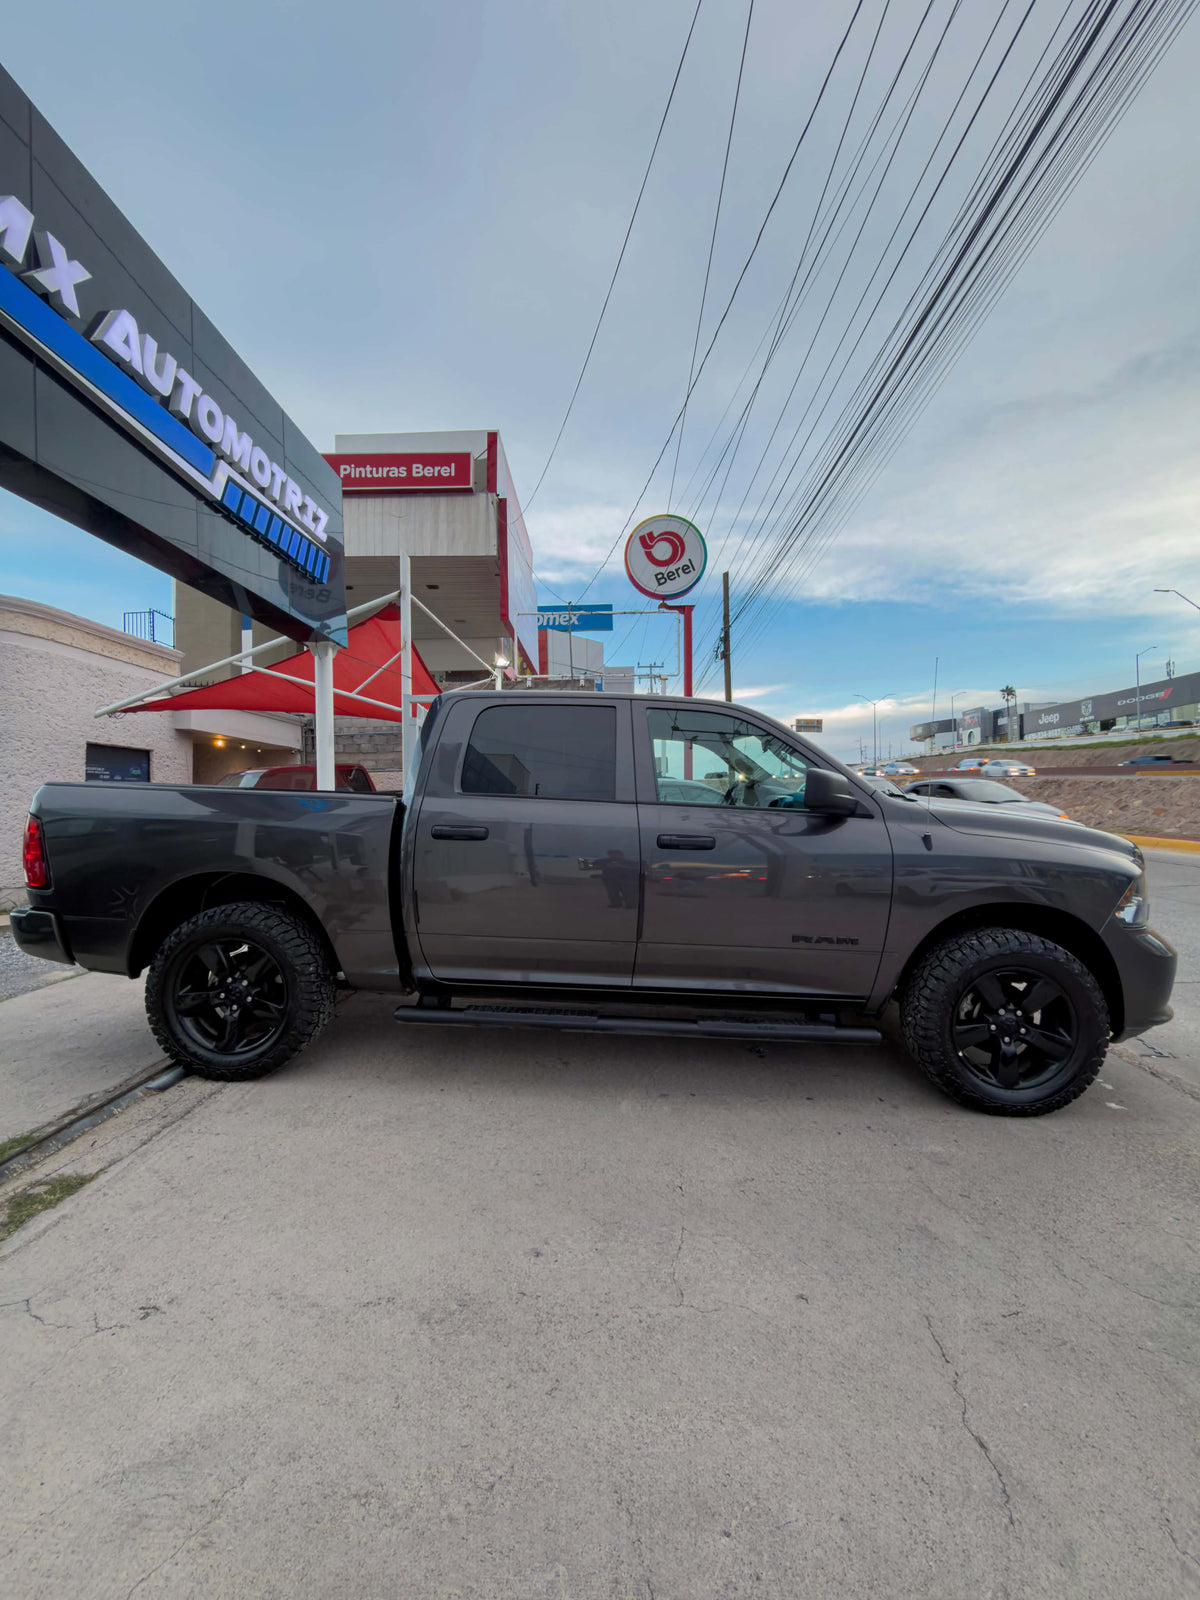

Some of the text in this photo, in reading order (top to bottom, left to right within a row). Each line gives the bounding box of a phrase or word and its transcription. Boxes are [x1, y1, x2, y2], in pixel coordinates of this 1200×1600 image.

[91, 309, 330, 542] AUTOMOTRIZ
[340, 462, 455, 478] Pinturas Berel
[654, 558, 696, 586] Berel
[1039, 713, 1059, 725] Jeep
[791, 935, 860, 945] RAM
